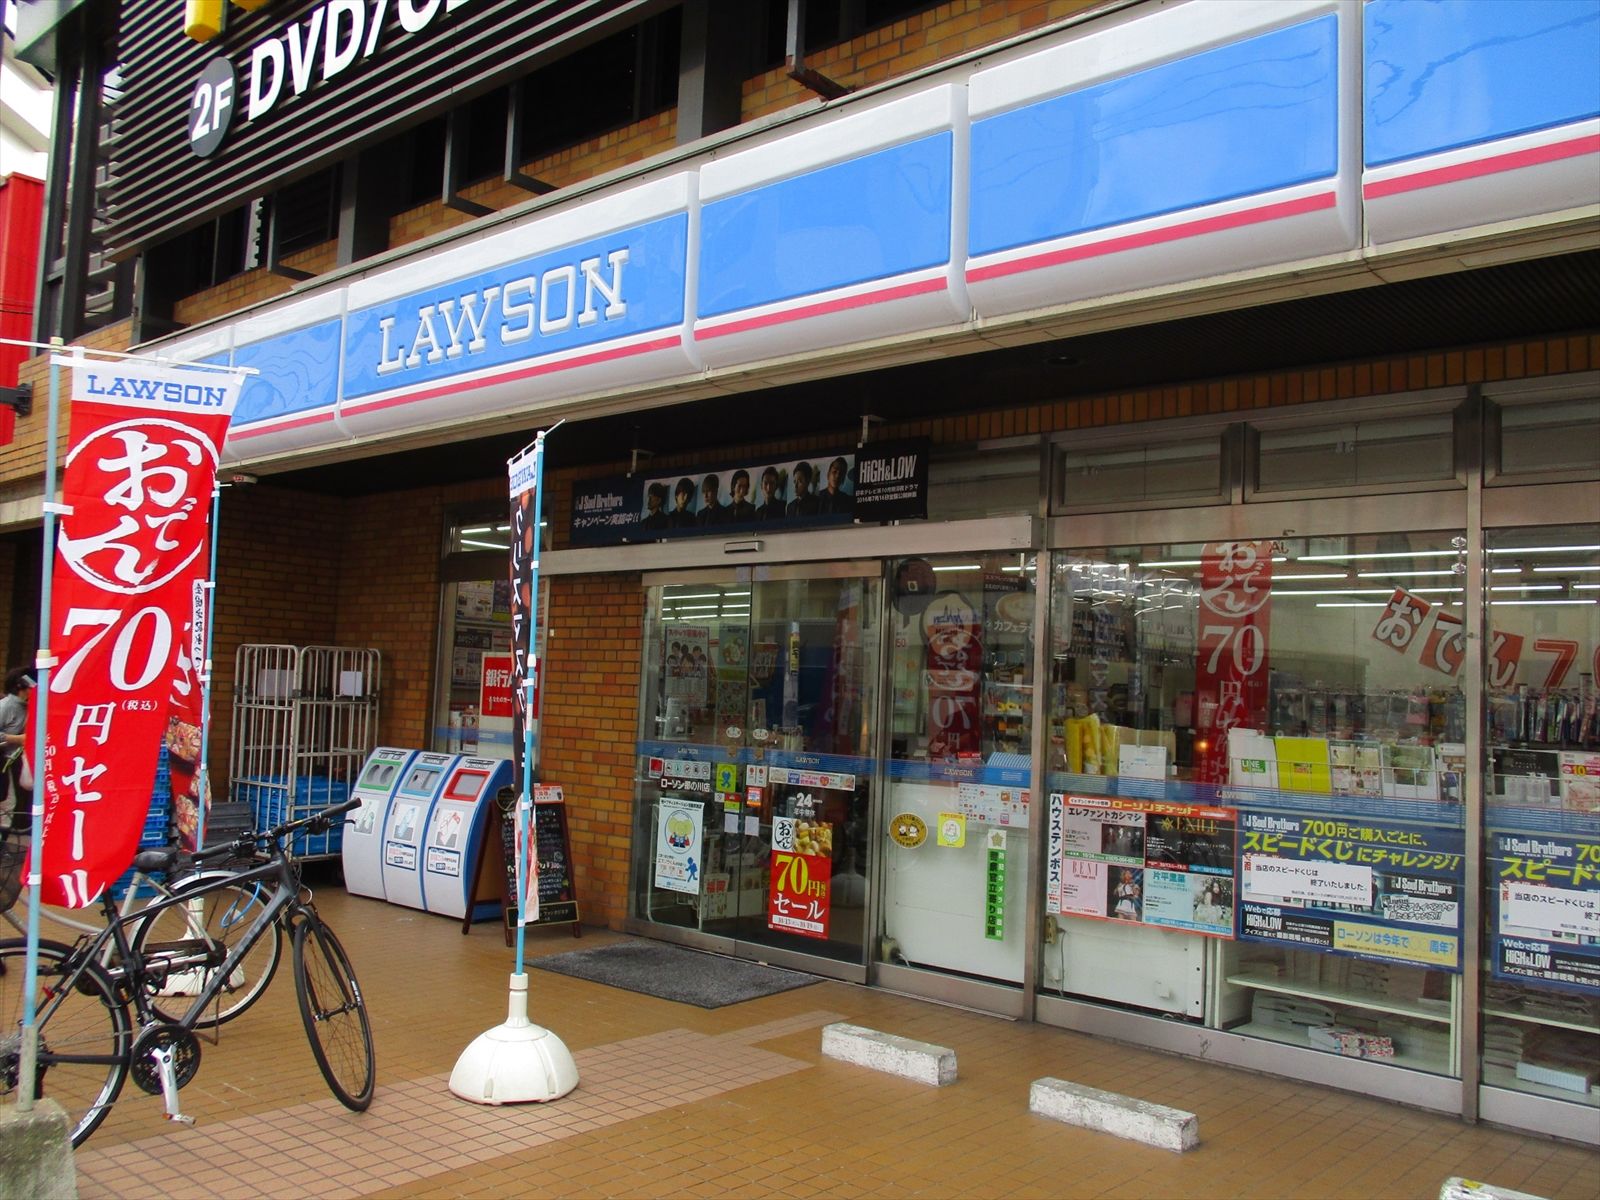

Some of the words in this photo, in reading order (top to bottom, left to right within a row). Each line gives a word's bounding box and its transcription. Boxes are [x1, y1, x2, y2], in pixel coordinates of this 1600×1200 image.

[191, 77, 233, 143] 2F
[377, 246, 629, 376] LAWSON
[87, 374, 227, 407] LAWSON
[64, 430, 203, 587] おでん
[50, 606, 172, 694] 70
[1202, 625, 1264, 676] 70
[943, 767, 974, 777] LAWSON
[796, 792, 813, 808] 24
[1112, 800, 1199, 816] ローソンチケット
[1068, 807, 1142, 822] エレファントカシマシ
[1176, 816, 1220, 833] EXILE
[1049, 795, 1062, 882] ハウステンボス
[1302, 819, 1428, 846] 700円ご購入ごとに、
[1242, 831, 1460, 871] スピードくじにチャレンジ!
[1531, 840, 1572, 857] Brothers
[775, 853, 809, 895] 70
[807, 880, 820, 898] 円
[1255, 864, 1319, 877] 当店のスピードくじは
[1310, 878, 1368, 892] 終了いたしました。
[1401, 877, 1418, 891] Soul
[1418, 879, 1453, 895] Brothers
[773, 892, 826, 920] セール
[1514, 892, 1595, 909] 当店のスピードくじは
[1337, 927, 1410, 949] ローソンは今年で
